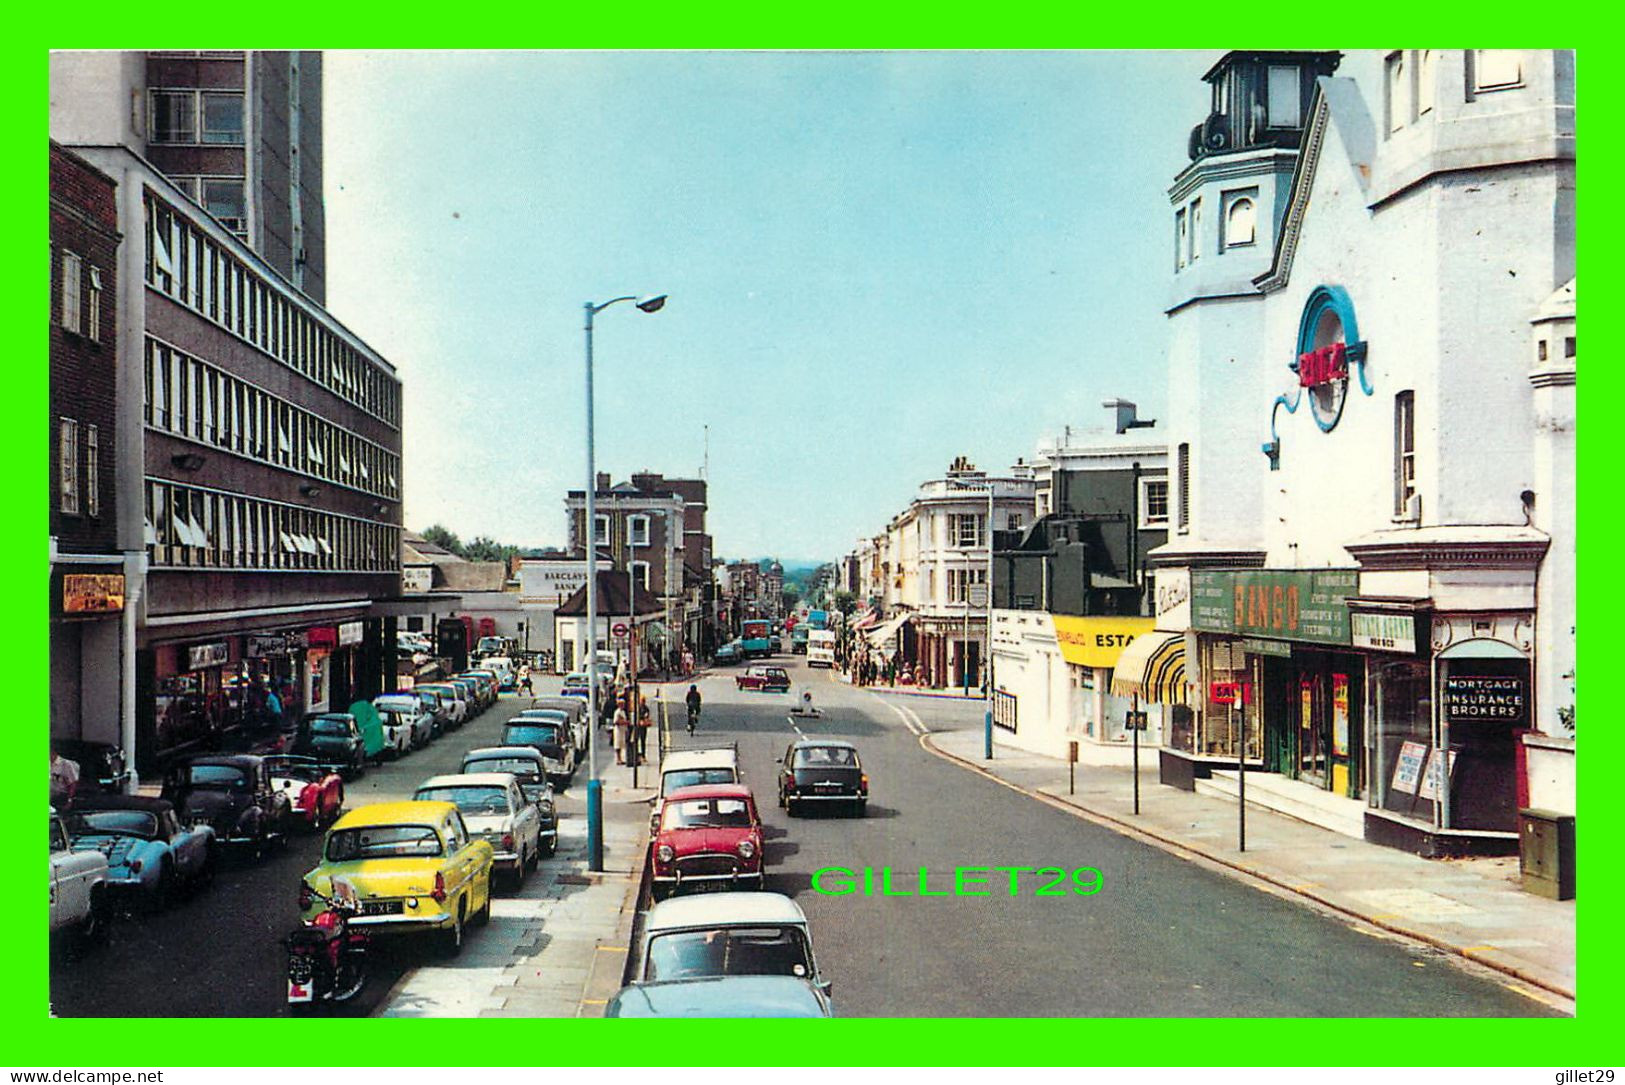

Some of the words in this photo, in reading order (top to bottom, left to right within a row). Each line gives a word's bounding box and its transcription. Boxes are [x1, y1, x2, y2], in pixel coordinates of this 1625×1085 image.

[554, 583, 577, 591] BANK
[1448, 680, 1518, 689] MORTGAGE
[1443, 694, 1522, 705] INSURANCE
[1451, 705, 1517, 716] BROKERS
